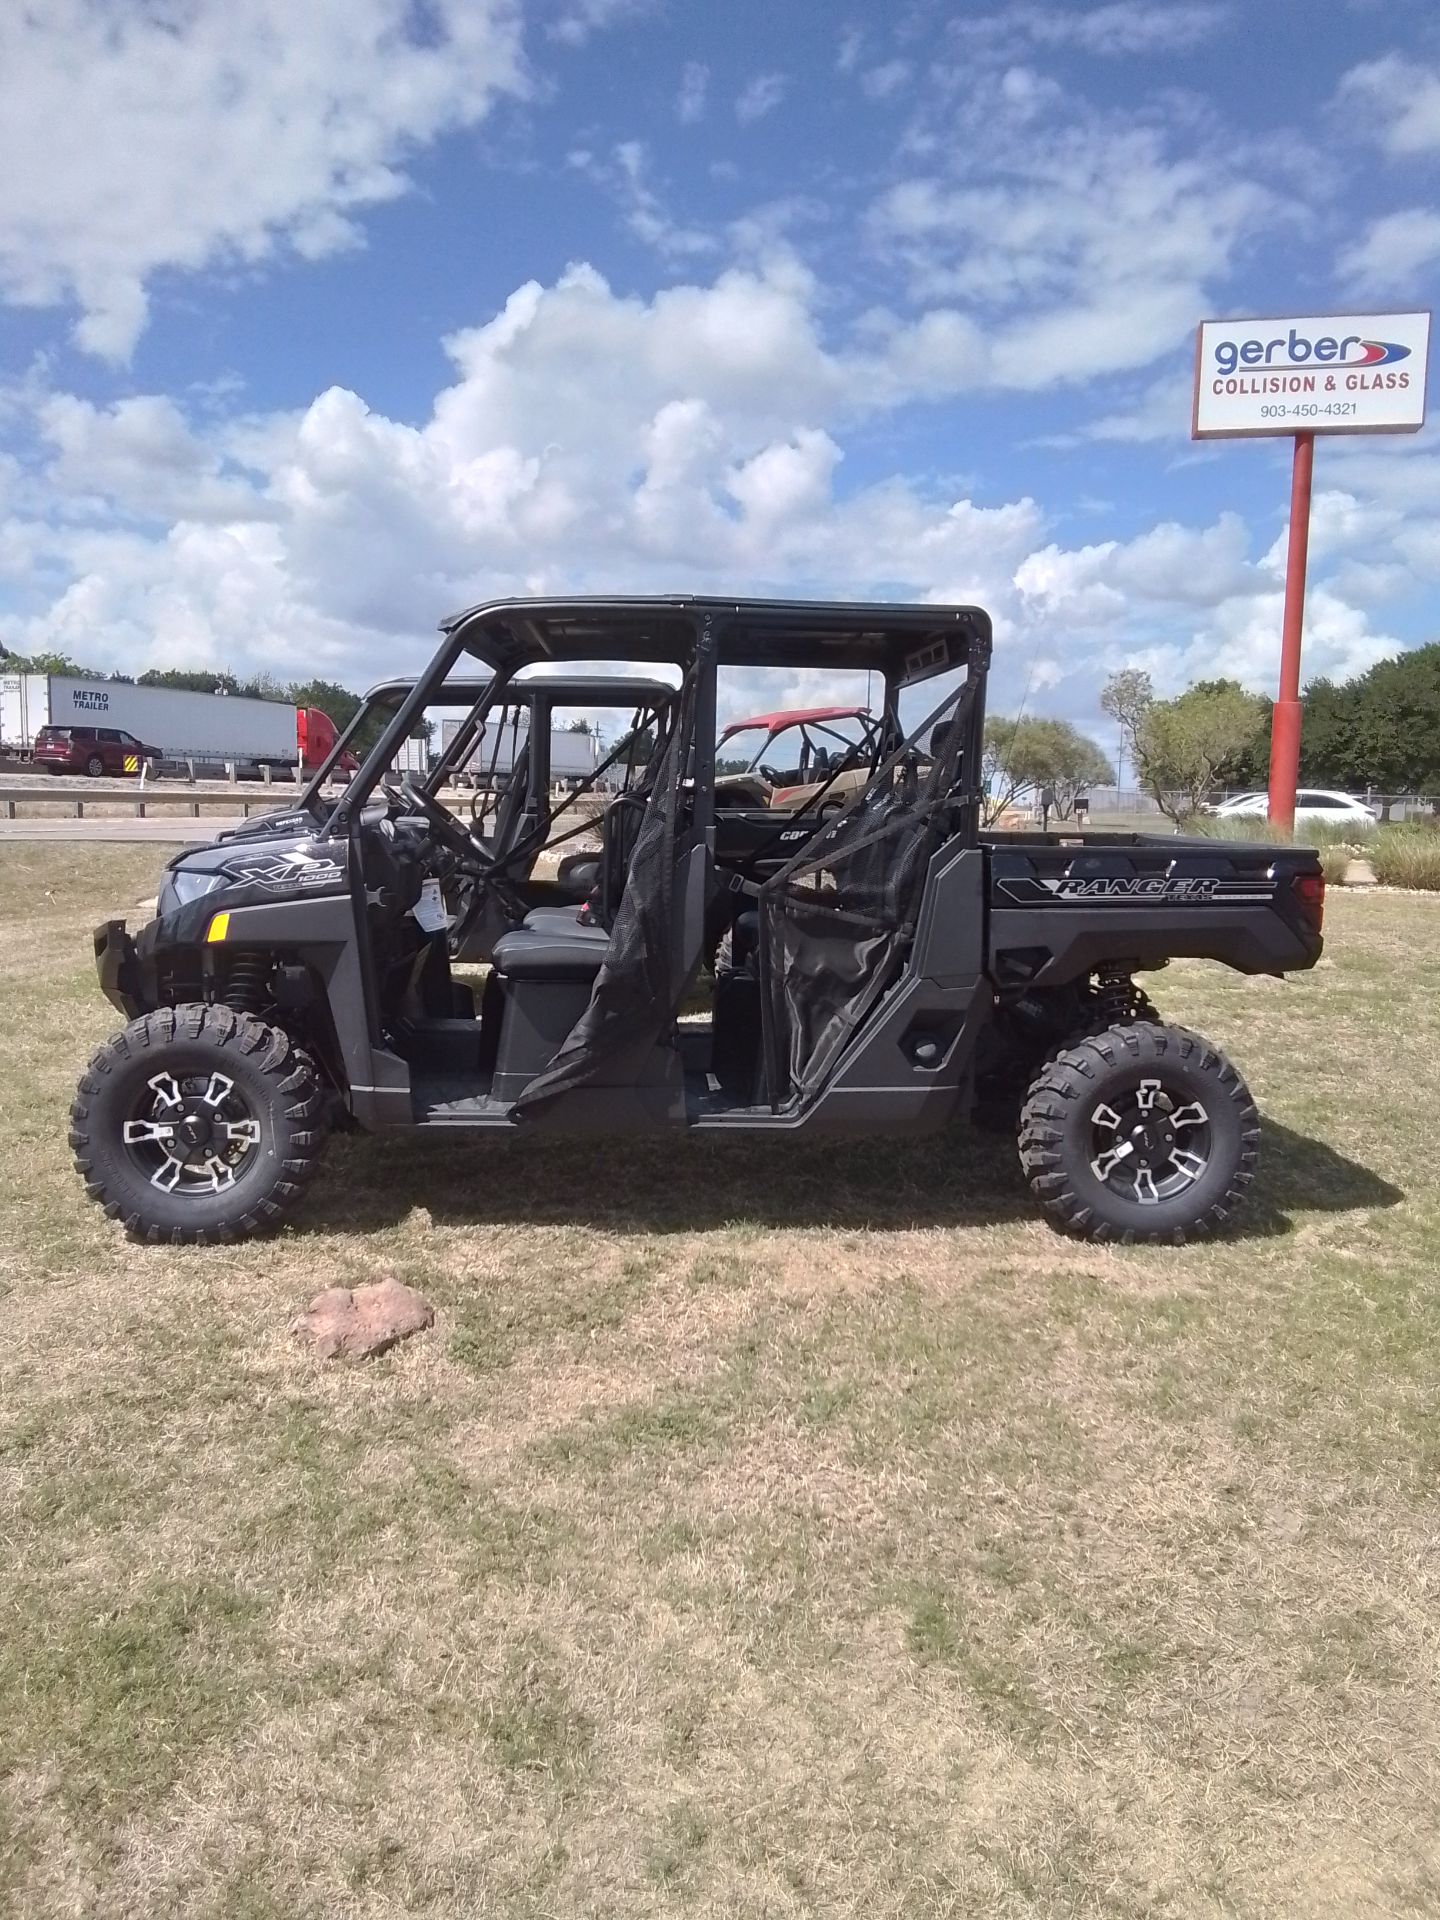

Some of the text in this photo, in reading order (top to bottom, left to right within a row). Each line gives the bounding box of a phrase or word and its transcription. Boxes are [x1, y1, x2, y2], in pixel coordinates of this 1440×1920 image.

[1214, 329, 1362, 376] gerber
[1212, 372, 1410, 395] COLLISION & GLASS
[1260, 402, 1358, 418] 903-450-4321
[73, 690, 109, 702] METRO
[74, 700, 109, 711] TRAILER
[298, 871, 342, 882] 1000
[1052, 878, 1220, 895] RANGER
